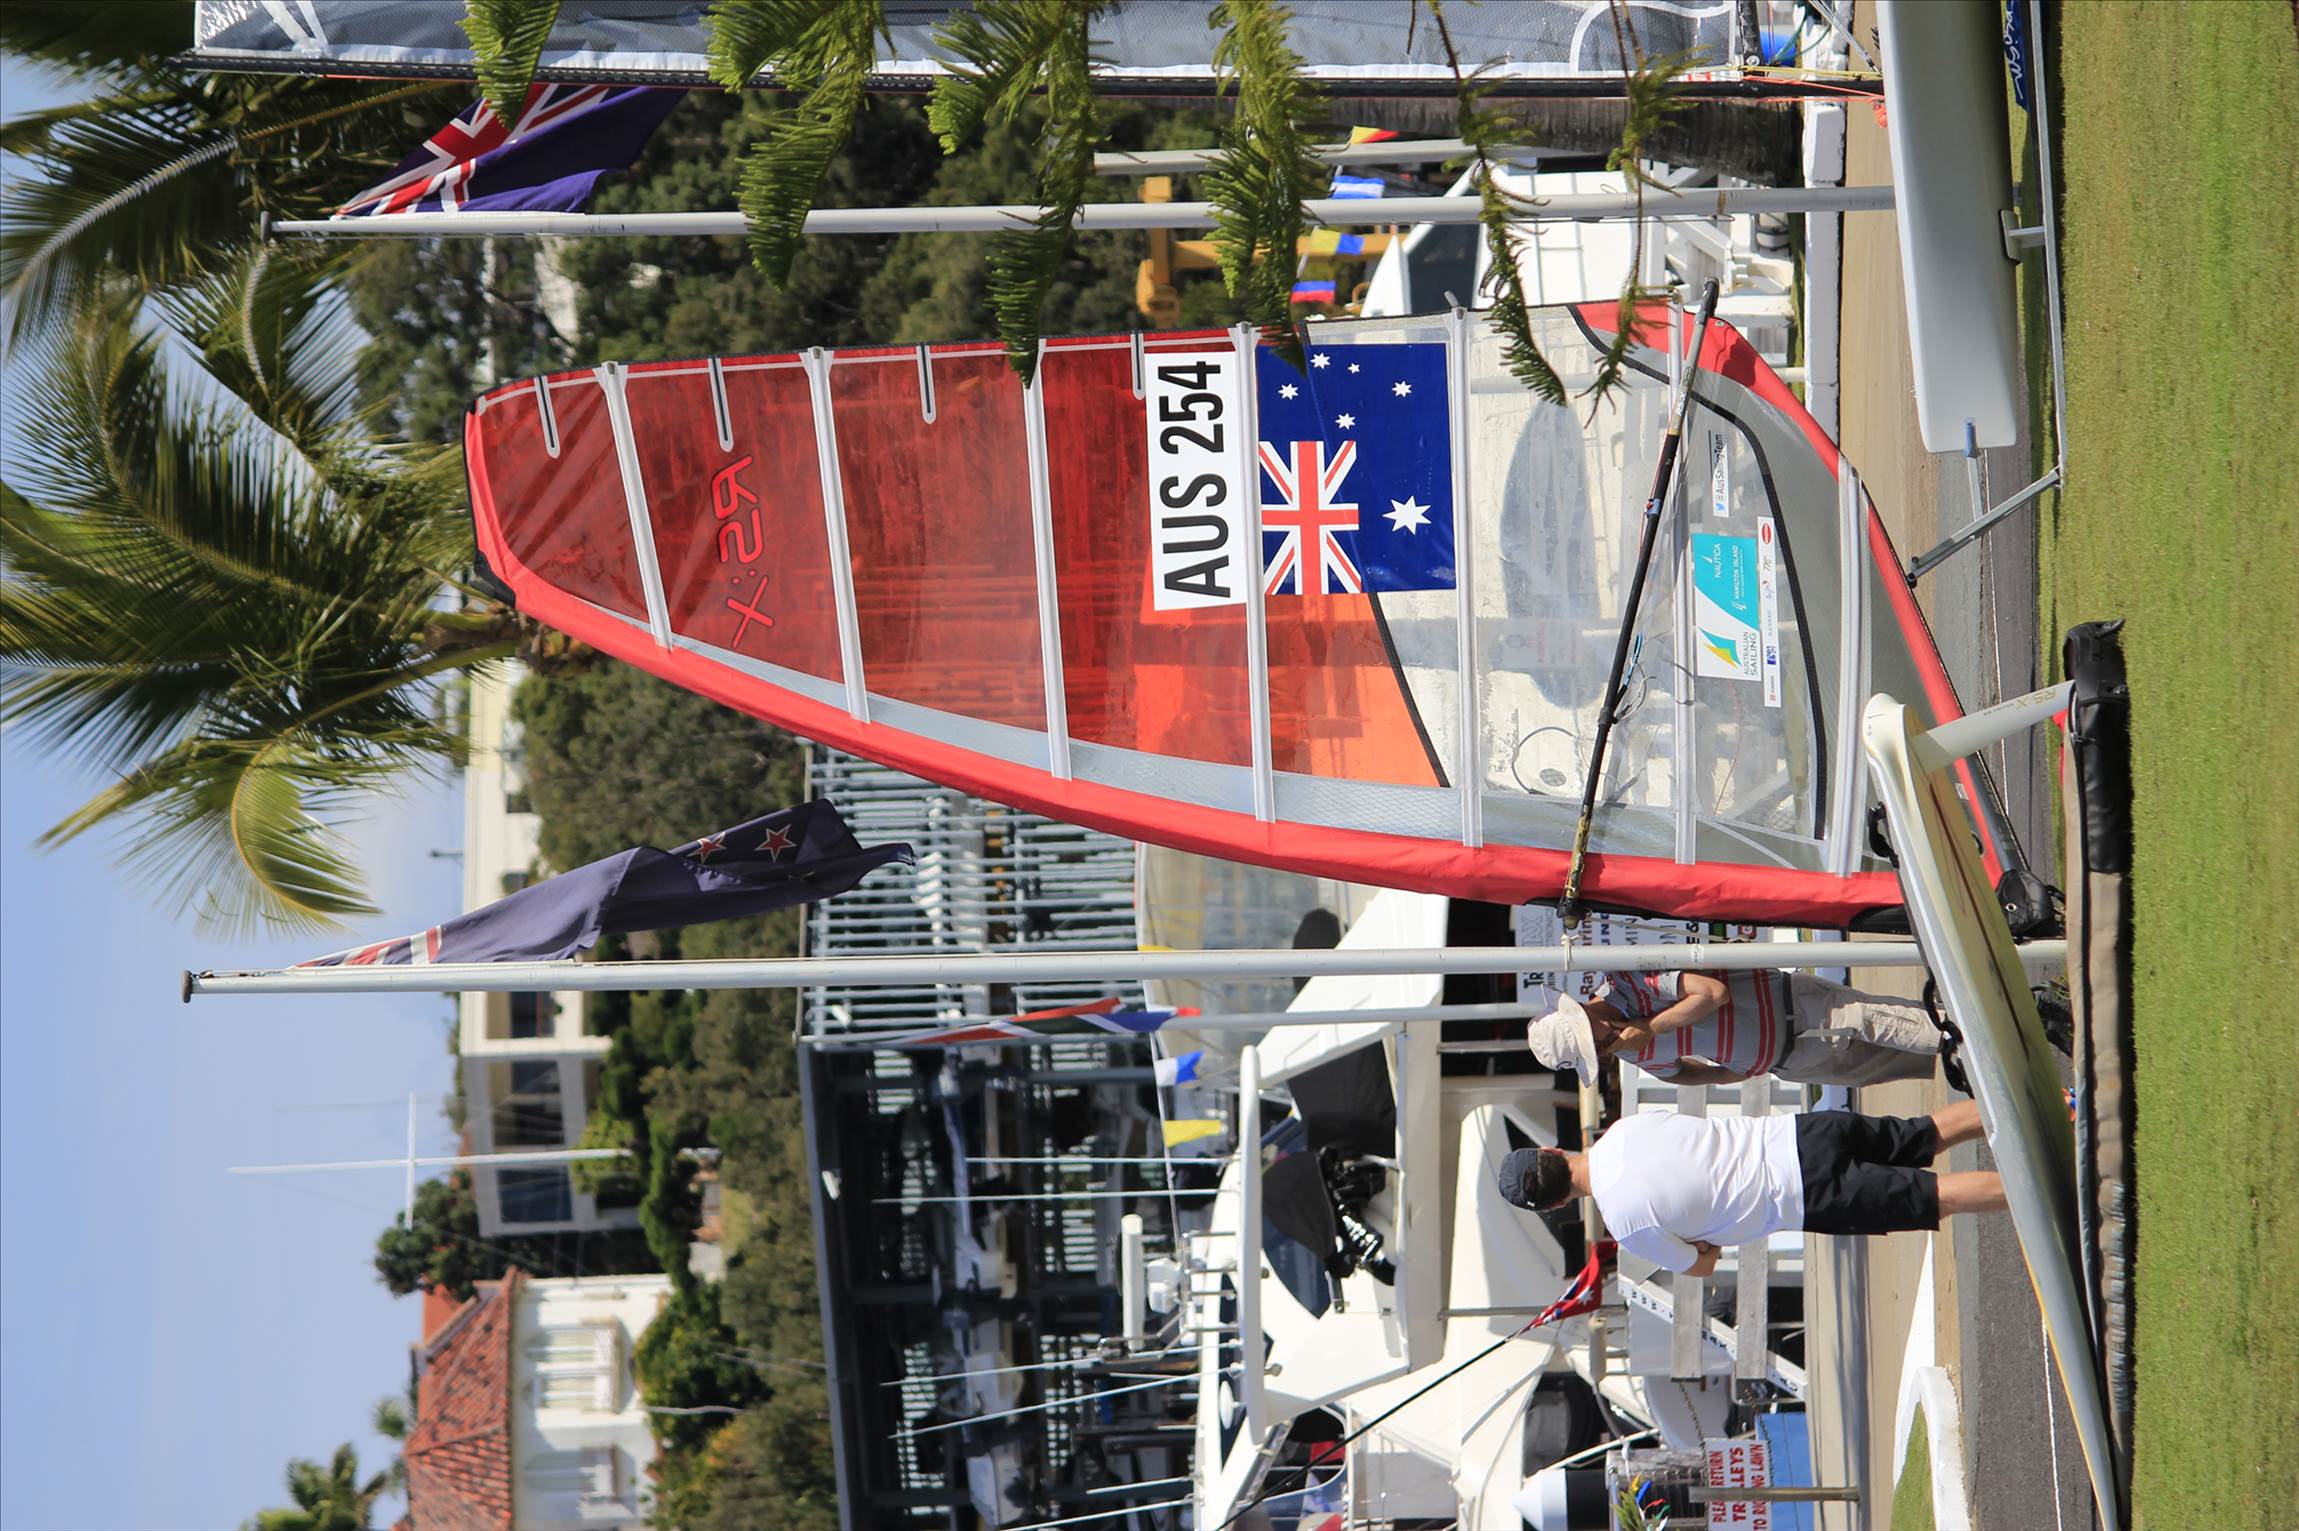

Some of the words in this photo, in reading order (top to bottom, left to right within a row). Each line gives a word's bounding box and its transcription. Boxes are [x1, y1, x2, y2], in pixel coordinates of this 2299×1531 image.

[1157, 360, 1224, 455] 254
[1158, 473, 1231, 598] AUS
[1713, 543, 1722, 579] NAUTICA
[1731, 544, 1739, 568] ISLAND
[1750, 631, 1758, 676] SAILING
[1709, 1451, 1724, 1486] RETURN
[1750, 1444, 1764, 1471] LAWN
[1730, 1448, 1746, 1522] TRLEYS
[1753, 1519, 1767, 1531] TO
